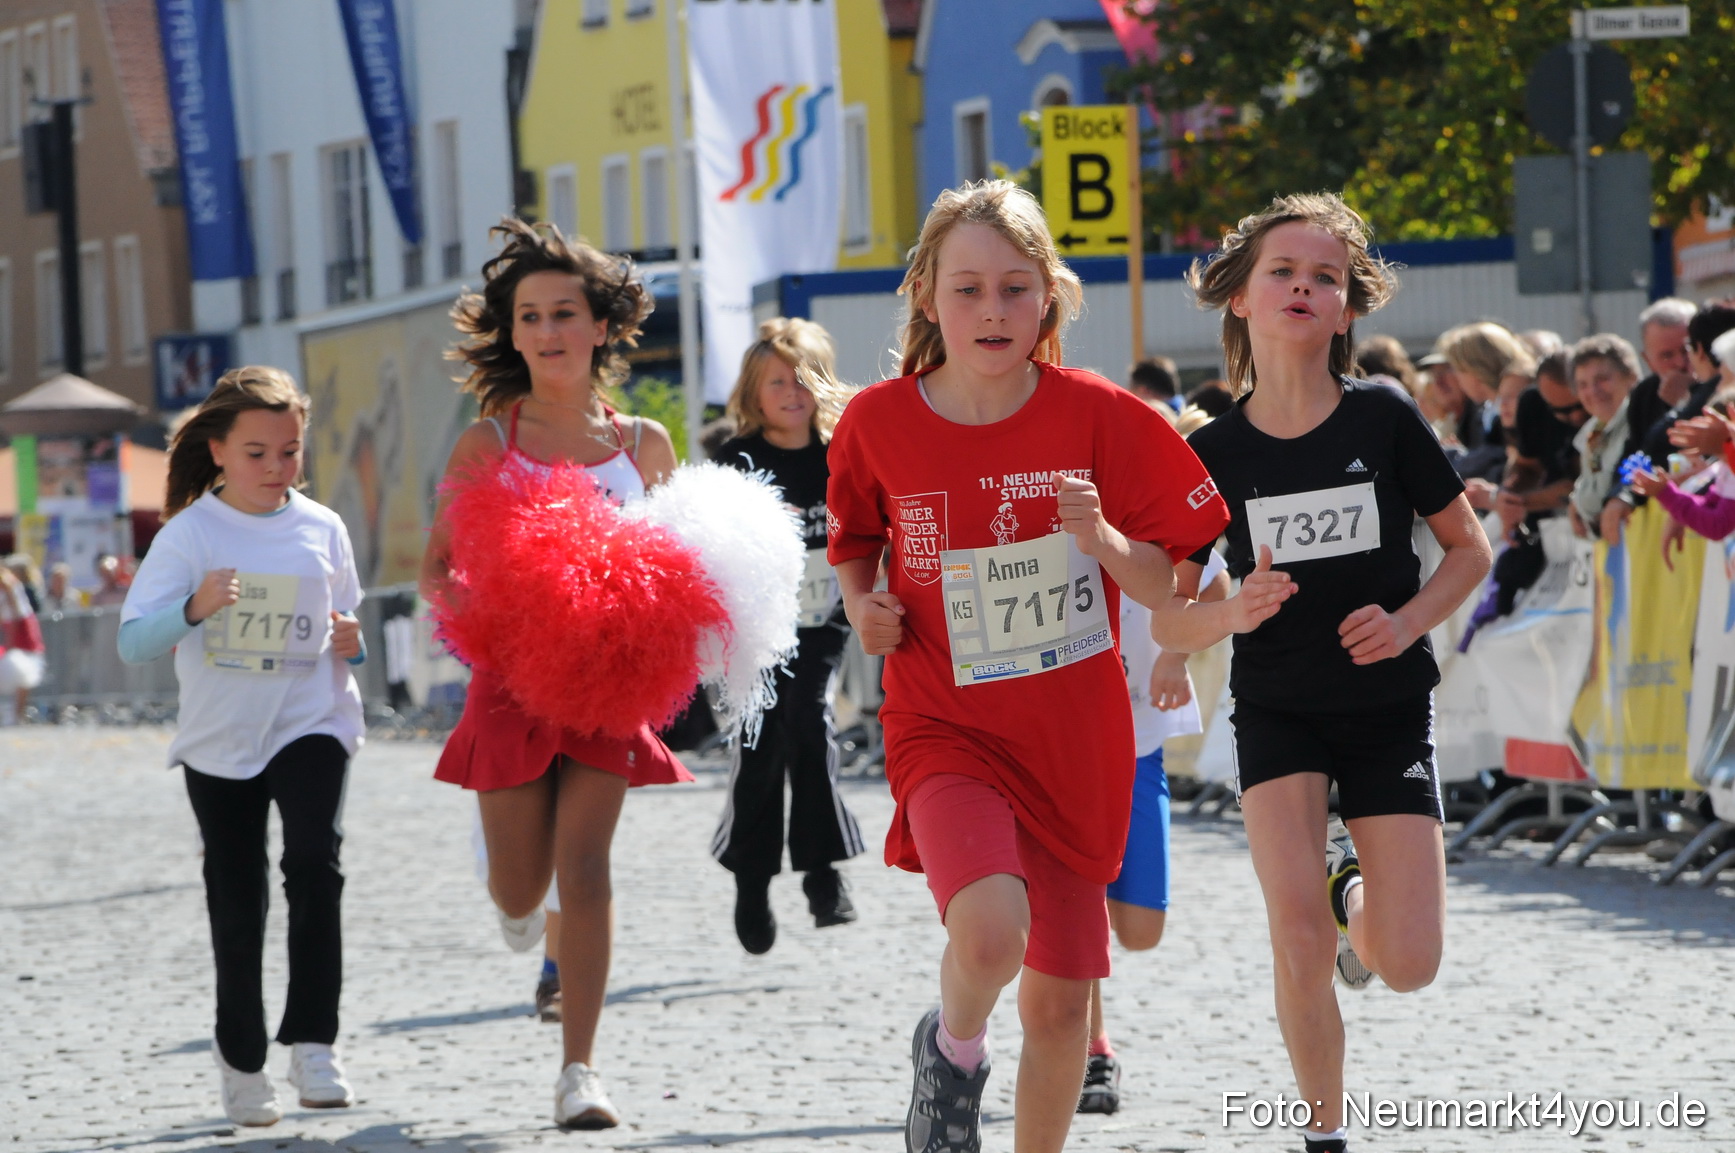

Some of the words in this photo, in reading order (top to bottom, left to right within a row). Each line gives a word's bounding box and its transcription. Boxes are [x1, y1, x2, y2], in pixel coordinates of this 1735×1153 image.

[1053, 113, 1126, 140] Block
[1069, 153, 1114, 221] B
[979, 476, 1000, 490] 11.
[1003, 468, 1093, 487] NEUMARKTE
[1000, 483, 1060, 501] STADTL
[1267, 505, 1364, 550] 7327
[903, 534, 937, 556] NEU
[904, 555, 940, 570] MARKT
[987, 557, 1040, 583] Anna
[993, 574, 1094, 634] 7175
[237, 611, 312, 641] 7179
[1057, 629, 1108, 658] PFLEIDERER
[971, 660, 1017, 677] BOCK
[1402, 771, 1430, 781] adidas
